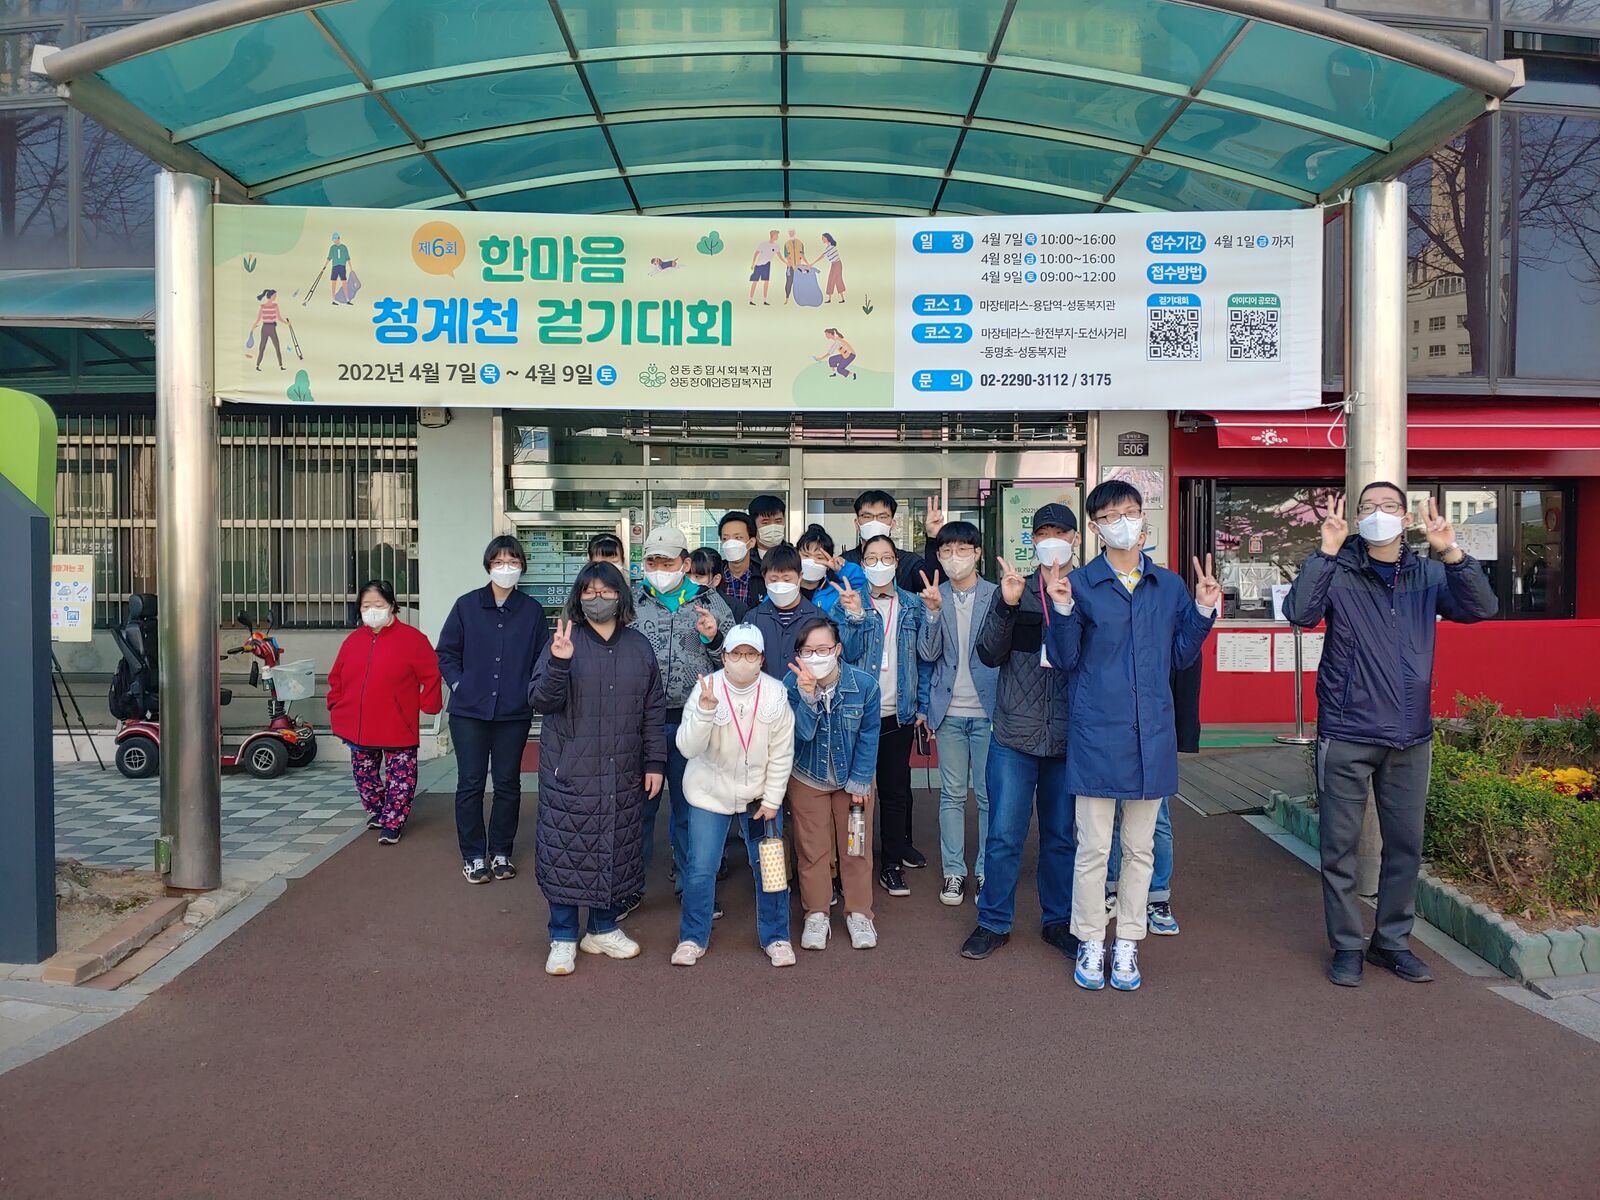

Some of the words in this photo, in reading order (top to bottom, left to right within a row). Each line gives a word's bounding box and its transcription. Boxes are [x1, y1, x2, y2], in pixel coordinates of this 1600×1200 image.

[920, 233, 934, 250] 일
[951, 233, 965, 250] 정
[981, 232, 1001, 247] 4월
[1040, 233, 1116, 246] 10:00~16:00
[1150, 234, 1203, 251] 접수기간
[1214, 234, 1233, 249] 4월
[1271, 234, 1294, 249] 까지
[418, 238, 457, 258] 제6회
[478, 235, 627, 284] 한마음
[980, 252, 1001, 267] 4월
[1040, 253, 1116, 265] 10:00~16:00
[981, 271, 1001, 284] 4월
[1040, 271, 1116, 283] 09:00~12:00
[1151, 265, 1203, 281] 접수방법
[923, 298, 950, 312] 코스
[953, 298, 962, 312] 1
[1158, 296, 1189, 305] 걷기대회
[1231, 296, 1257, 305] 아이디어
[1258, 296, 1277, 305] 공모전
[372, 297, 519, 345] 청계천
[537, 299, 732, 347] 걷기대회
[924, 326, 950, 340] 코스
[954, 326, 963, 339] 2
[337, 362, 405, 383] 2022년
[409, 362, 440, 384] 4월
[524, 363, 556, 385] 4월
[669, 364, 773, 376] 성동종합사회복지관
[669, 376, 773, 389] 성동장애인종합복지관
[918, 373, 934, 388] 문
[949, 373, 964, 388] 의
[980, 373, 1069, 387] 02-2290-3112
[1080, 373, 1112, 387] 3175
[1123, 443, 1144, 455] 506
